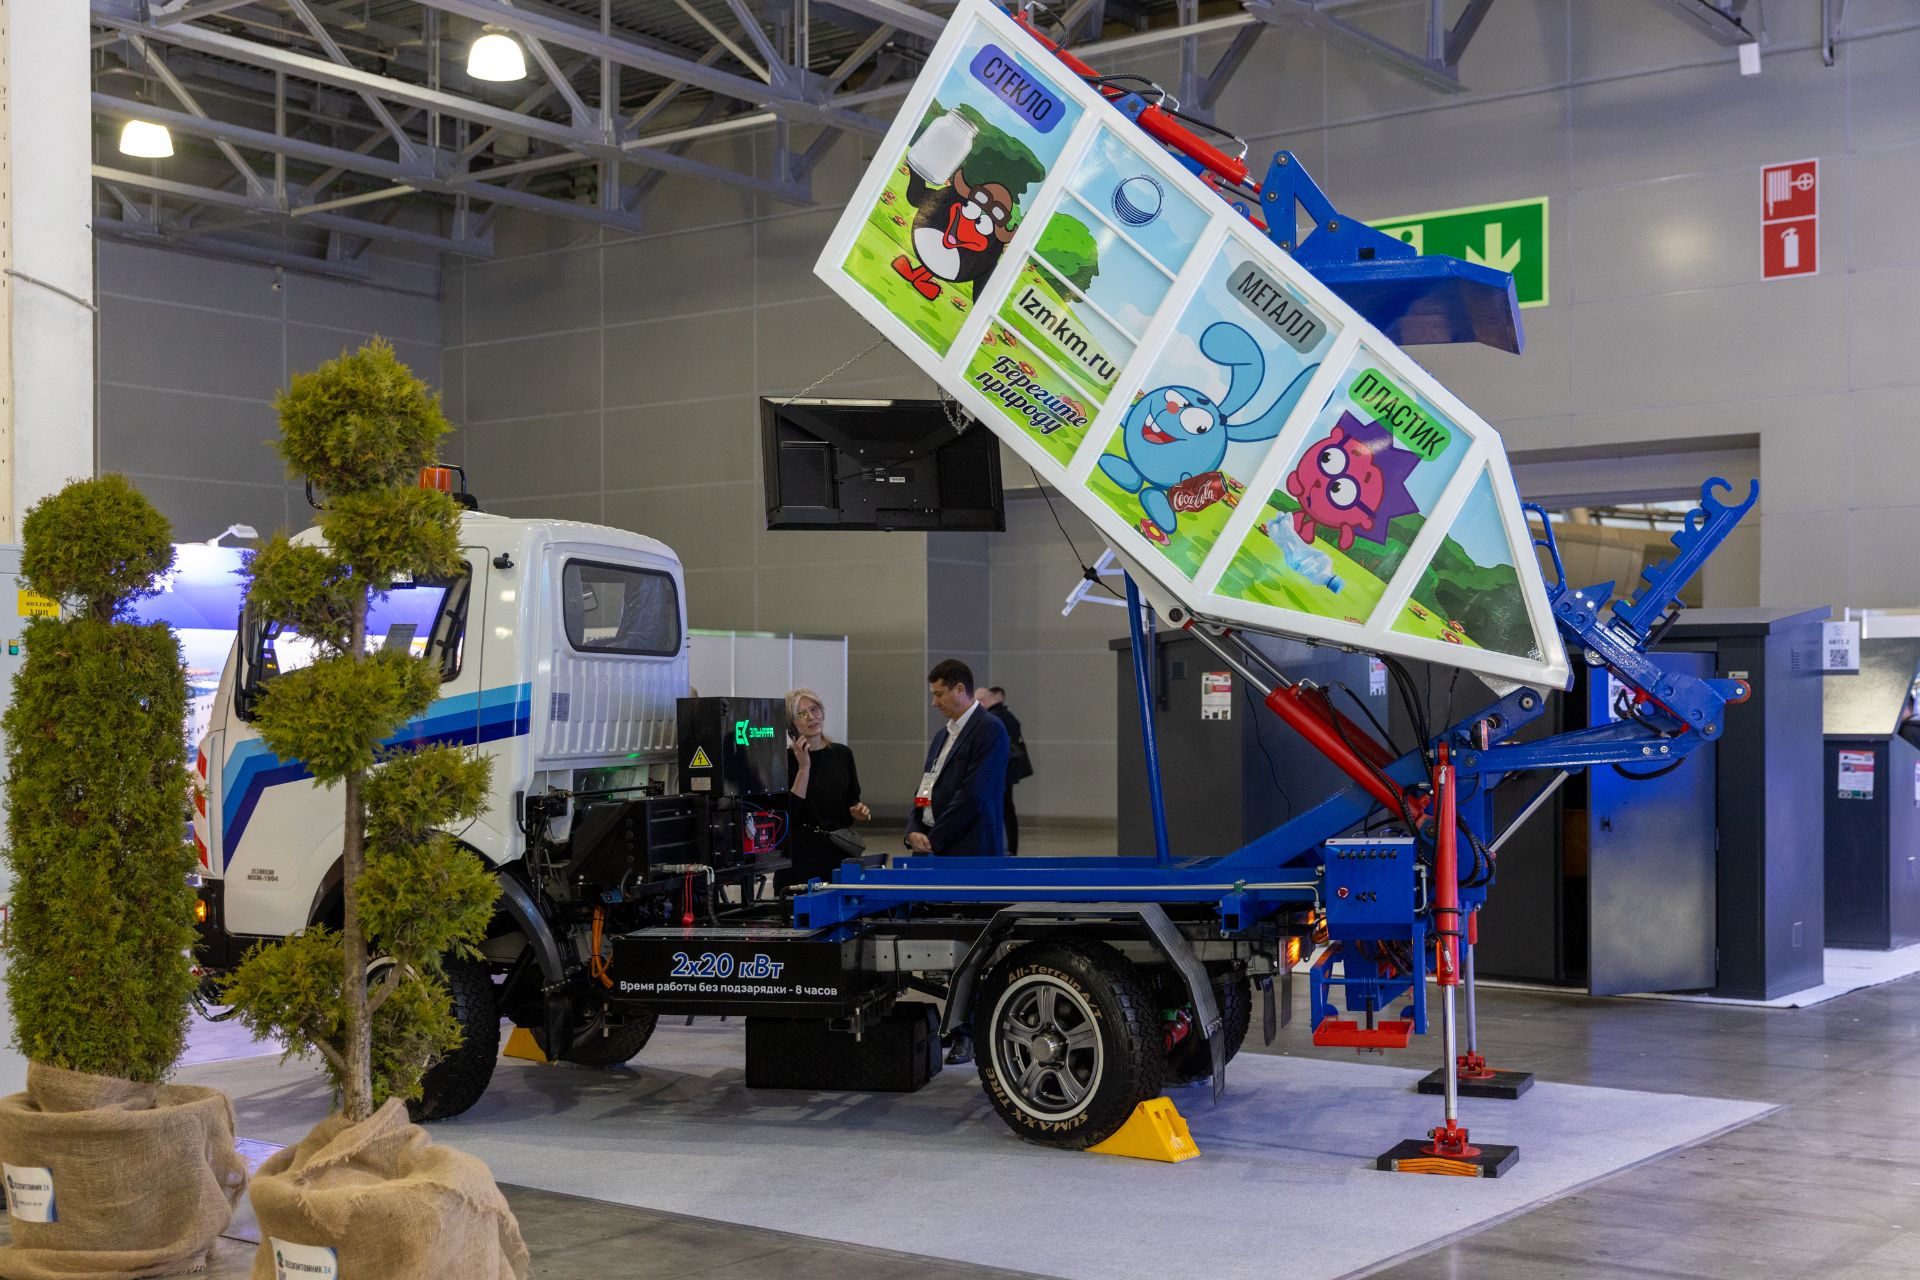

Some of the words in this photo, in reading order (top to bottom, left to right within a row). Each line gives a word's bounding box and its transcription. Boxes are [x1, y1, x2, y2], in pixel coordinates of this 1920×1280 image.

[983, 56, 1052, 121] СТЕКЛО
[1018, 288, 1116, 381] Izmkm.ru
[1237, 271, 1317, 345] МЕТАЛЛ
[974, 370, 1063, 436] природу
[991, 355, 1089, 428] Берегите
[1353, 373, 1448, 457] ПЛАСТИК
[620, 980, 655, 993] Время
[656, 981, 697, 994] работы
[698, 982, 718, 992] без
[720, 983, 787, 996] подзарядки
[795, 985, 802, 995] 8
[804, 986, 838, 996] часов
[738, 953, 784, 979] кВт
[1008, 964, 1082, 992] All-Terrain
